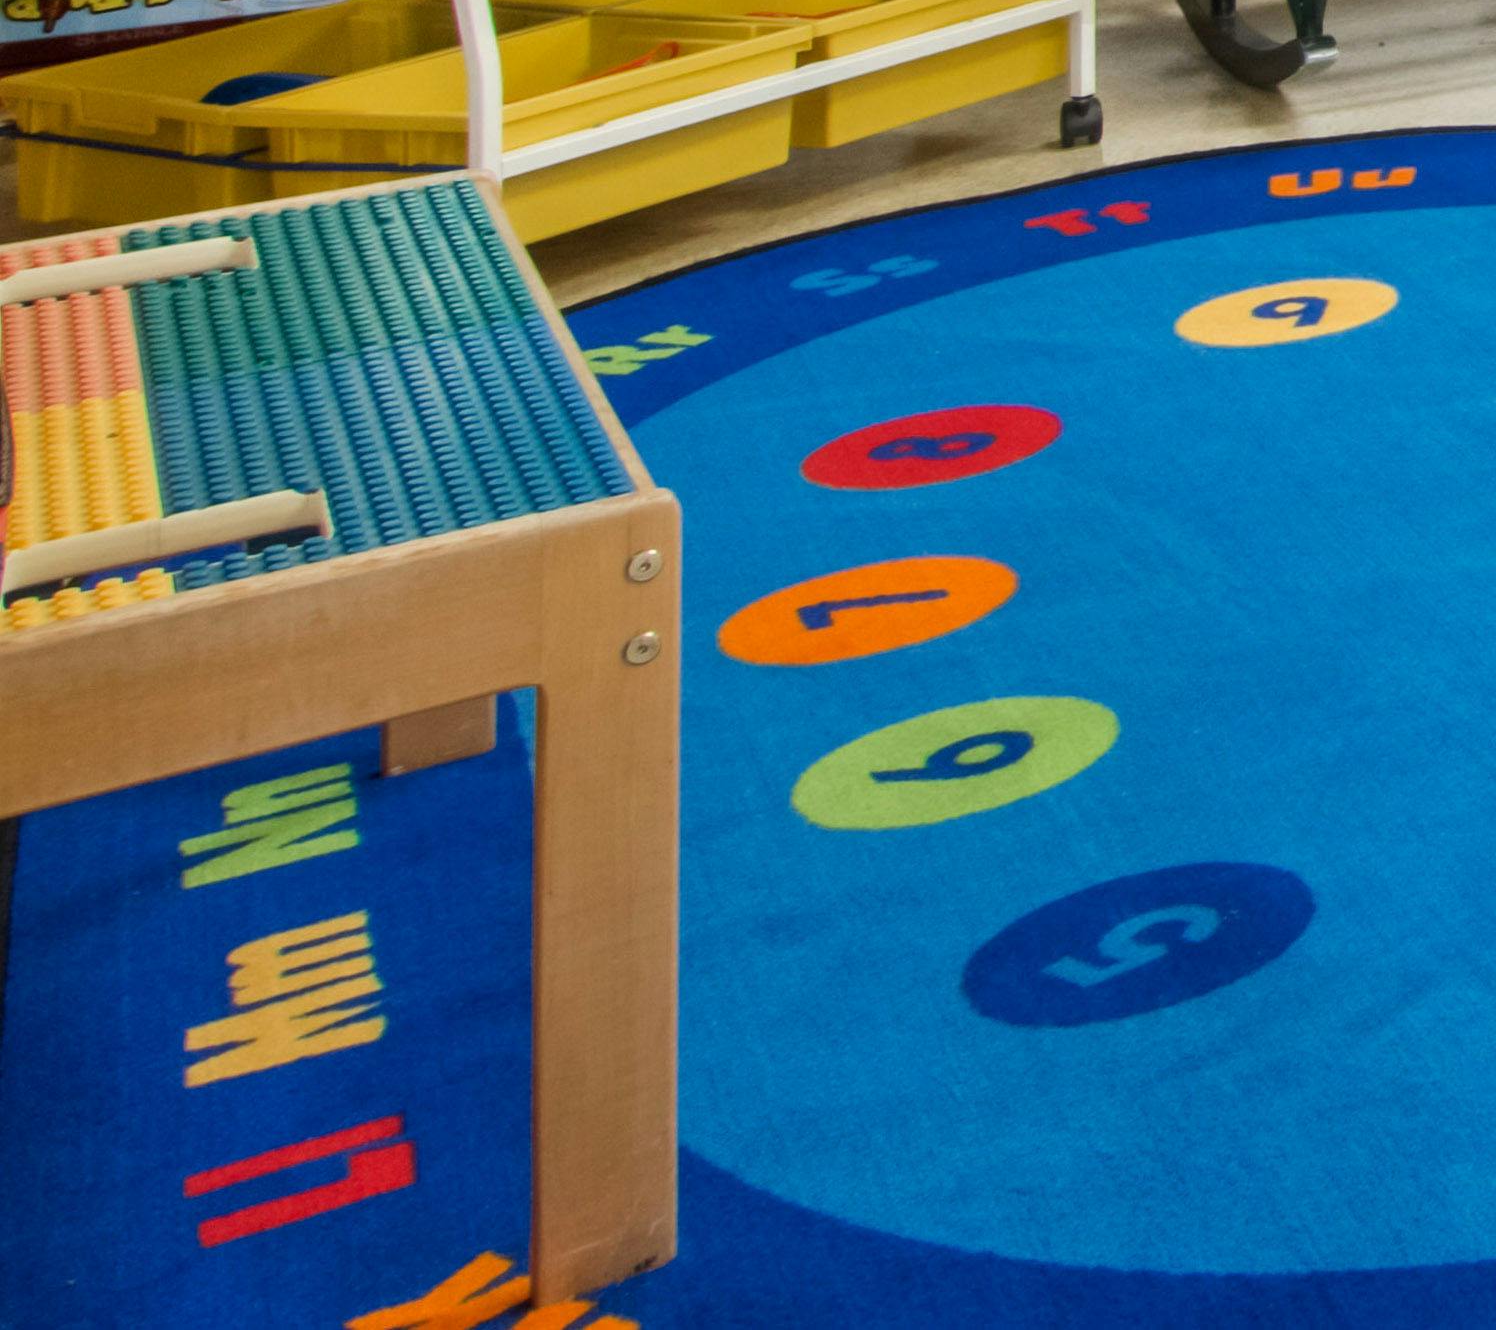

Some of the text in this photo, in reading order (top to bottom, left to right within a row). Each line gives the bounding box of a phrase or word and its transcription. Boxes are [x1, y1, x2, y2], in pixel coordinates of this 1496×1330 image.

[1267, 166, 1418, 201] Uu
[1024, 199, 1153, 238] Tt
[789, 254, 939, 298] Ss
[1248, 294, 1330, 330] 9
[866, 430, 998, 465] 8
[177, 762, 362, 891] Nn
[1042, 905, 1222, 990] 5
[182, 907, 389, 1090] Mm
[182, 1111, 418, 1250] Ll
